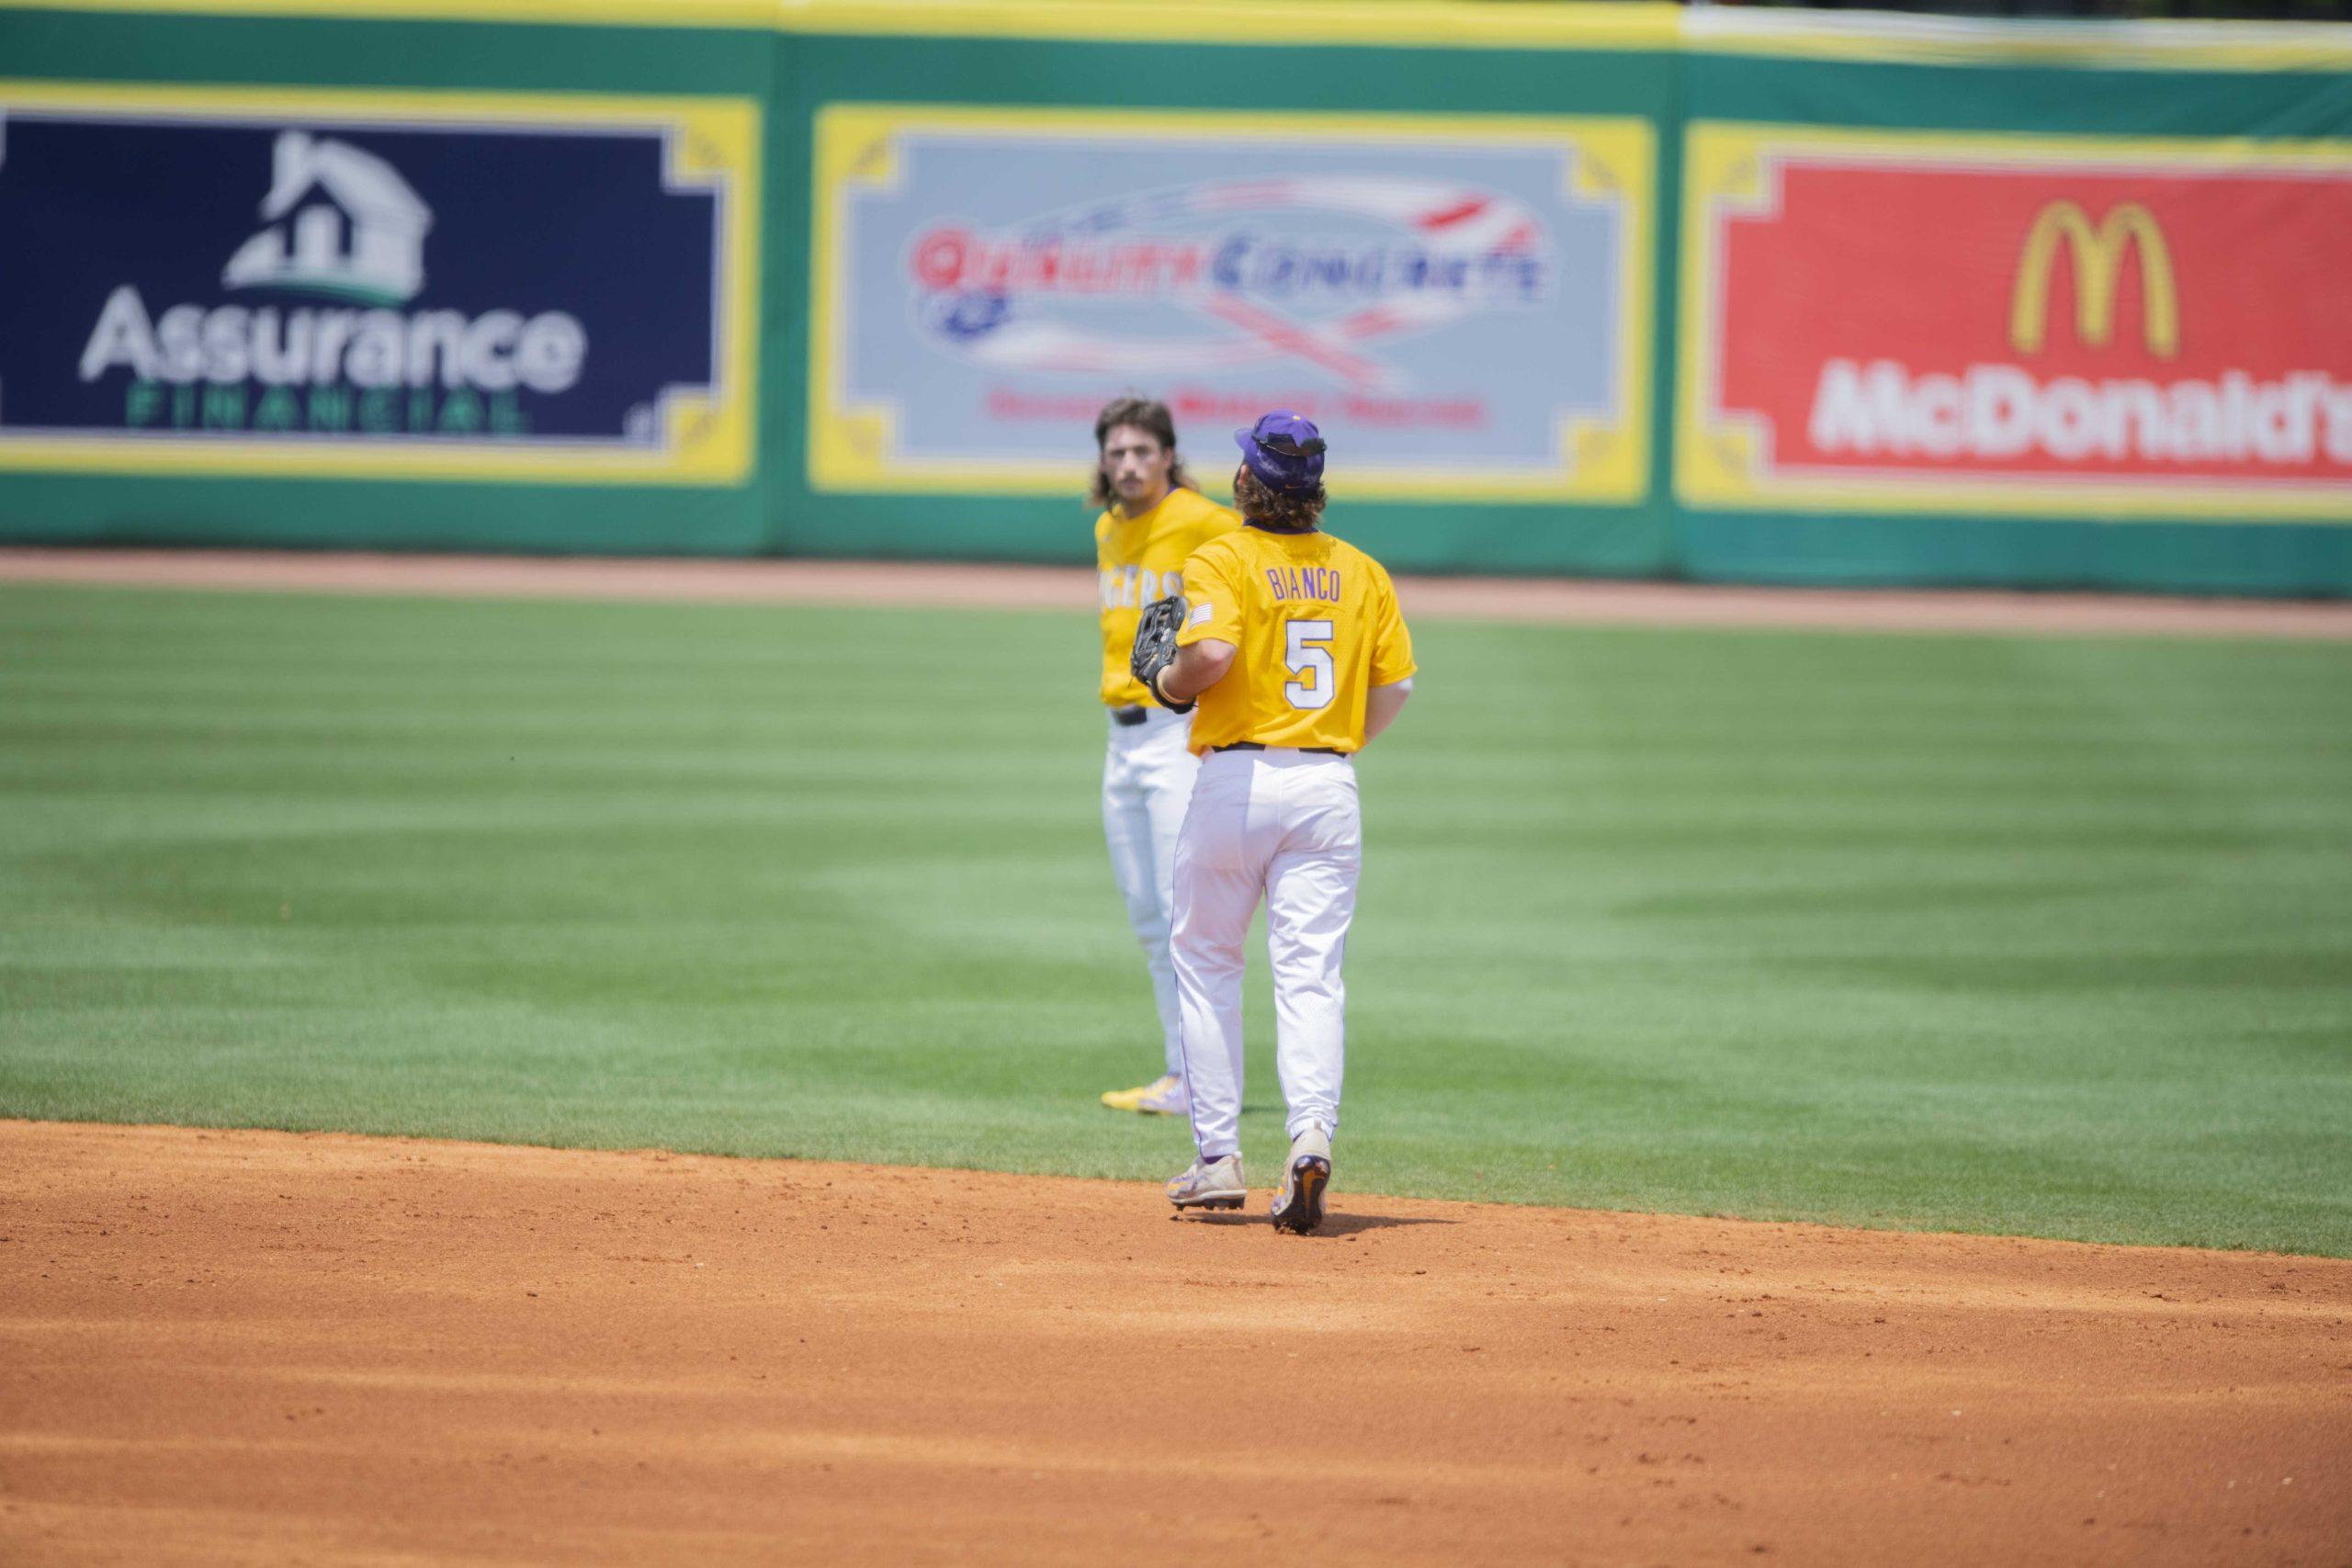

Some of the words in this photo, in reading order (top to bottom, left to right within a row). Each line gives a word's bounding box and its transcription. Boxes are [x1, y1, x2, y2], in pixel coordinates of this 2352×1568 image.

[79, 283, 588, 393] Assurance
[125, 378, 529, 435] FINANCIAL
[1266, 567, 1340, 603] BIANCO
[1284, 619, 1335, 709] 5
